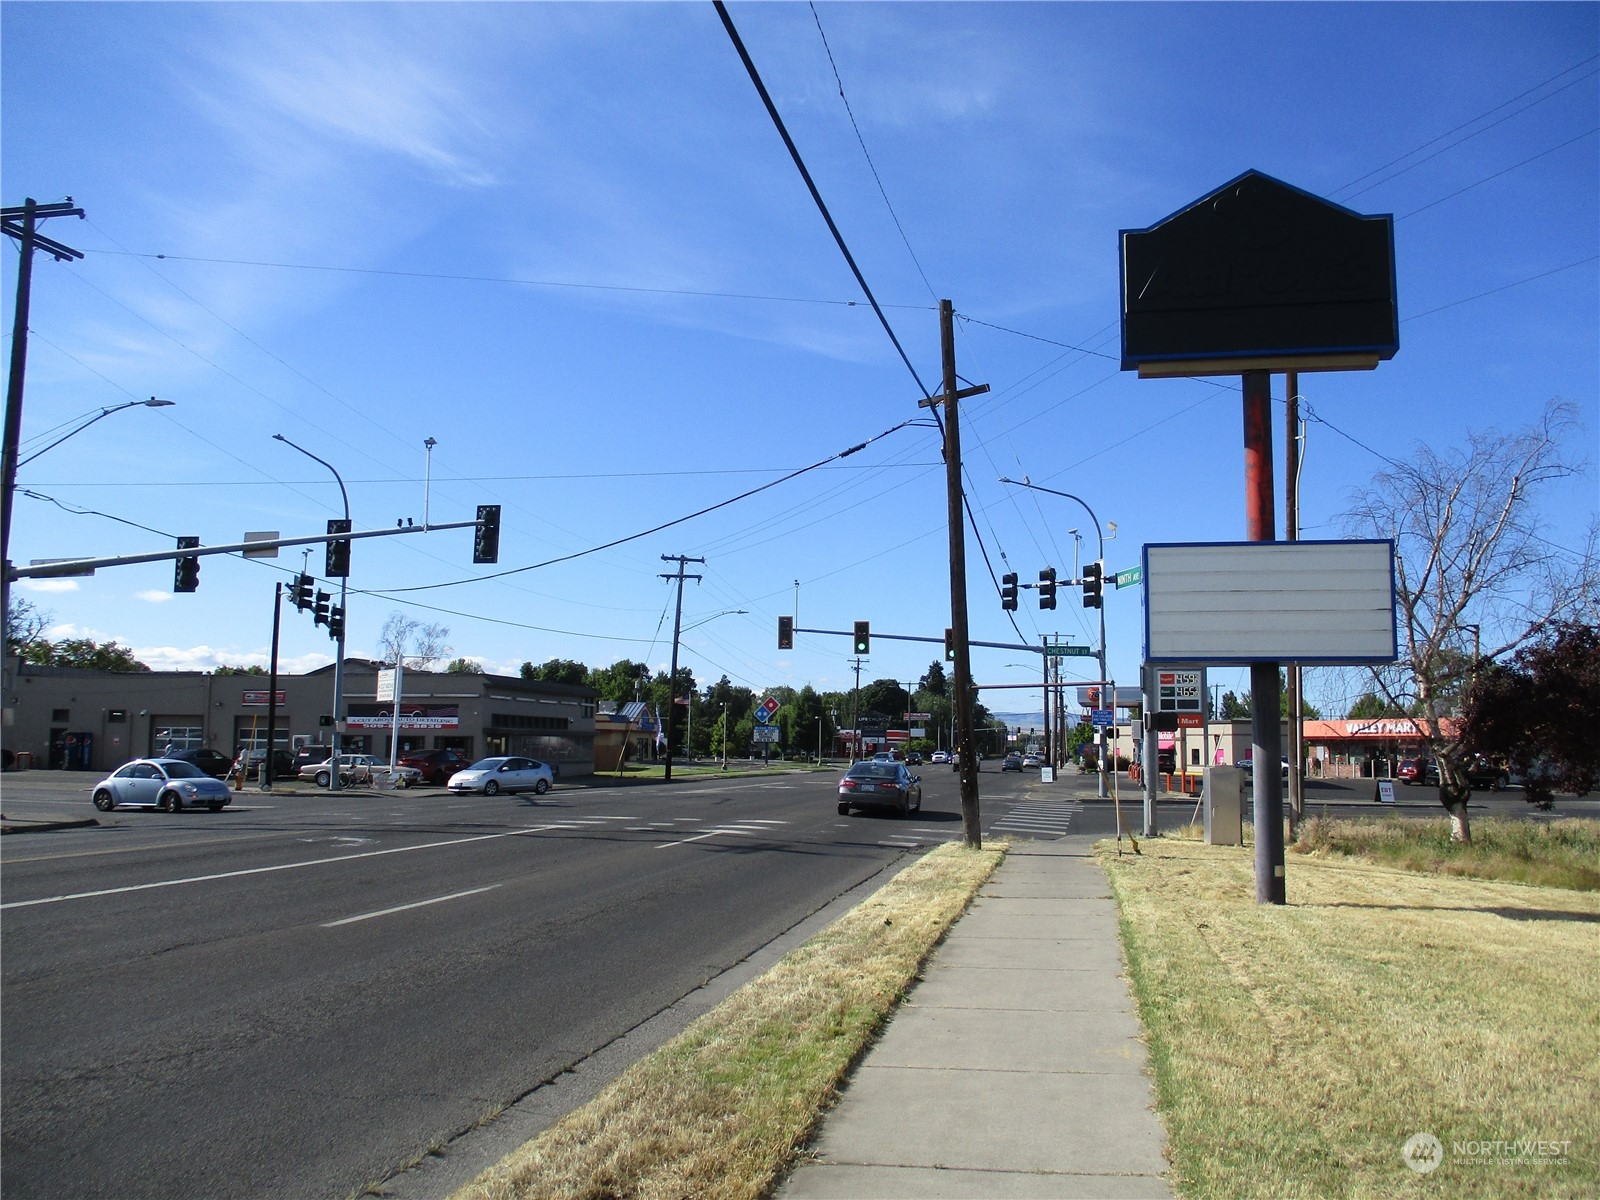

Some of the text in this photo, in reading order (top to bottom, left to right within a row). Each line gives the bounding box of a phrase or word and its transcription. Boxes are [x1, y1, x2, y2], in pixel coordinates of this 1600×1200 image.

[1117, 573, 1131, 586] NINTH
[1047, 647, 1079, 655] CHESTNUT
[1345, 722, 1384, 734] VALLEY
